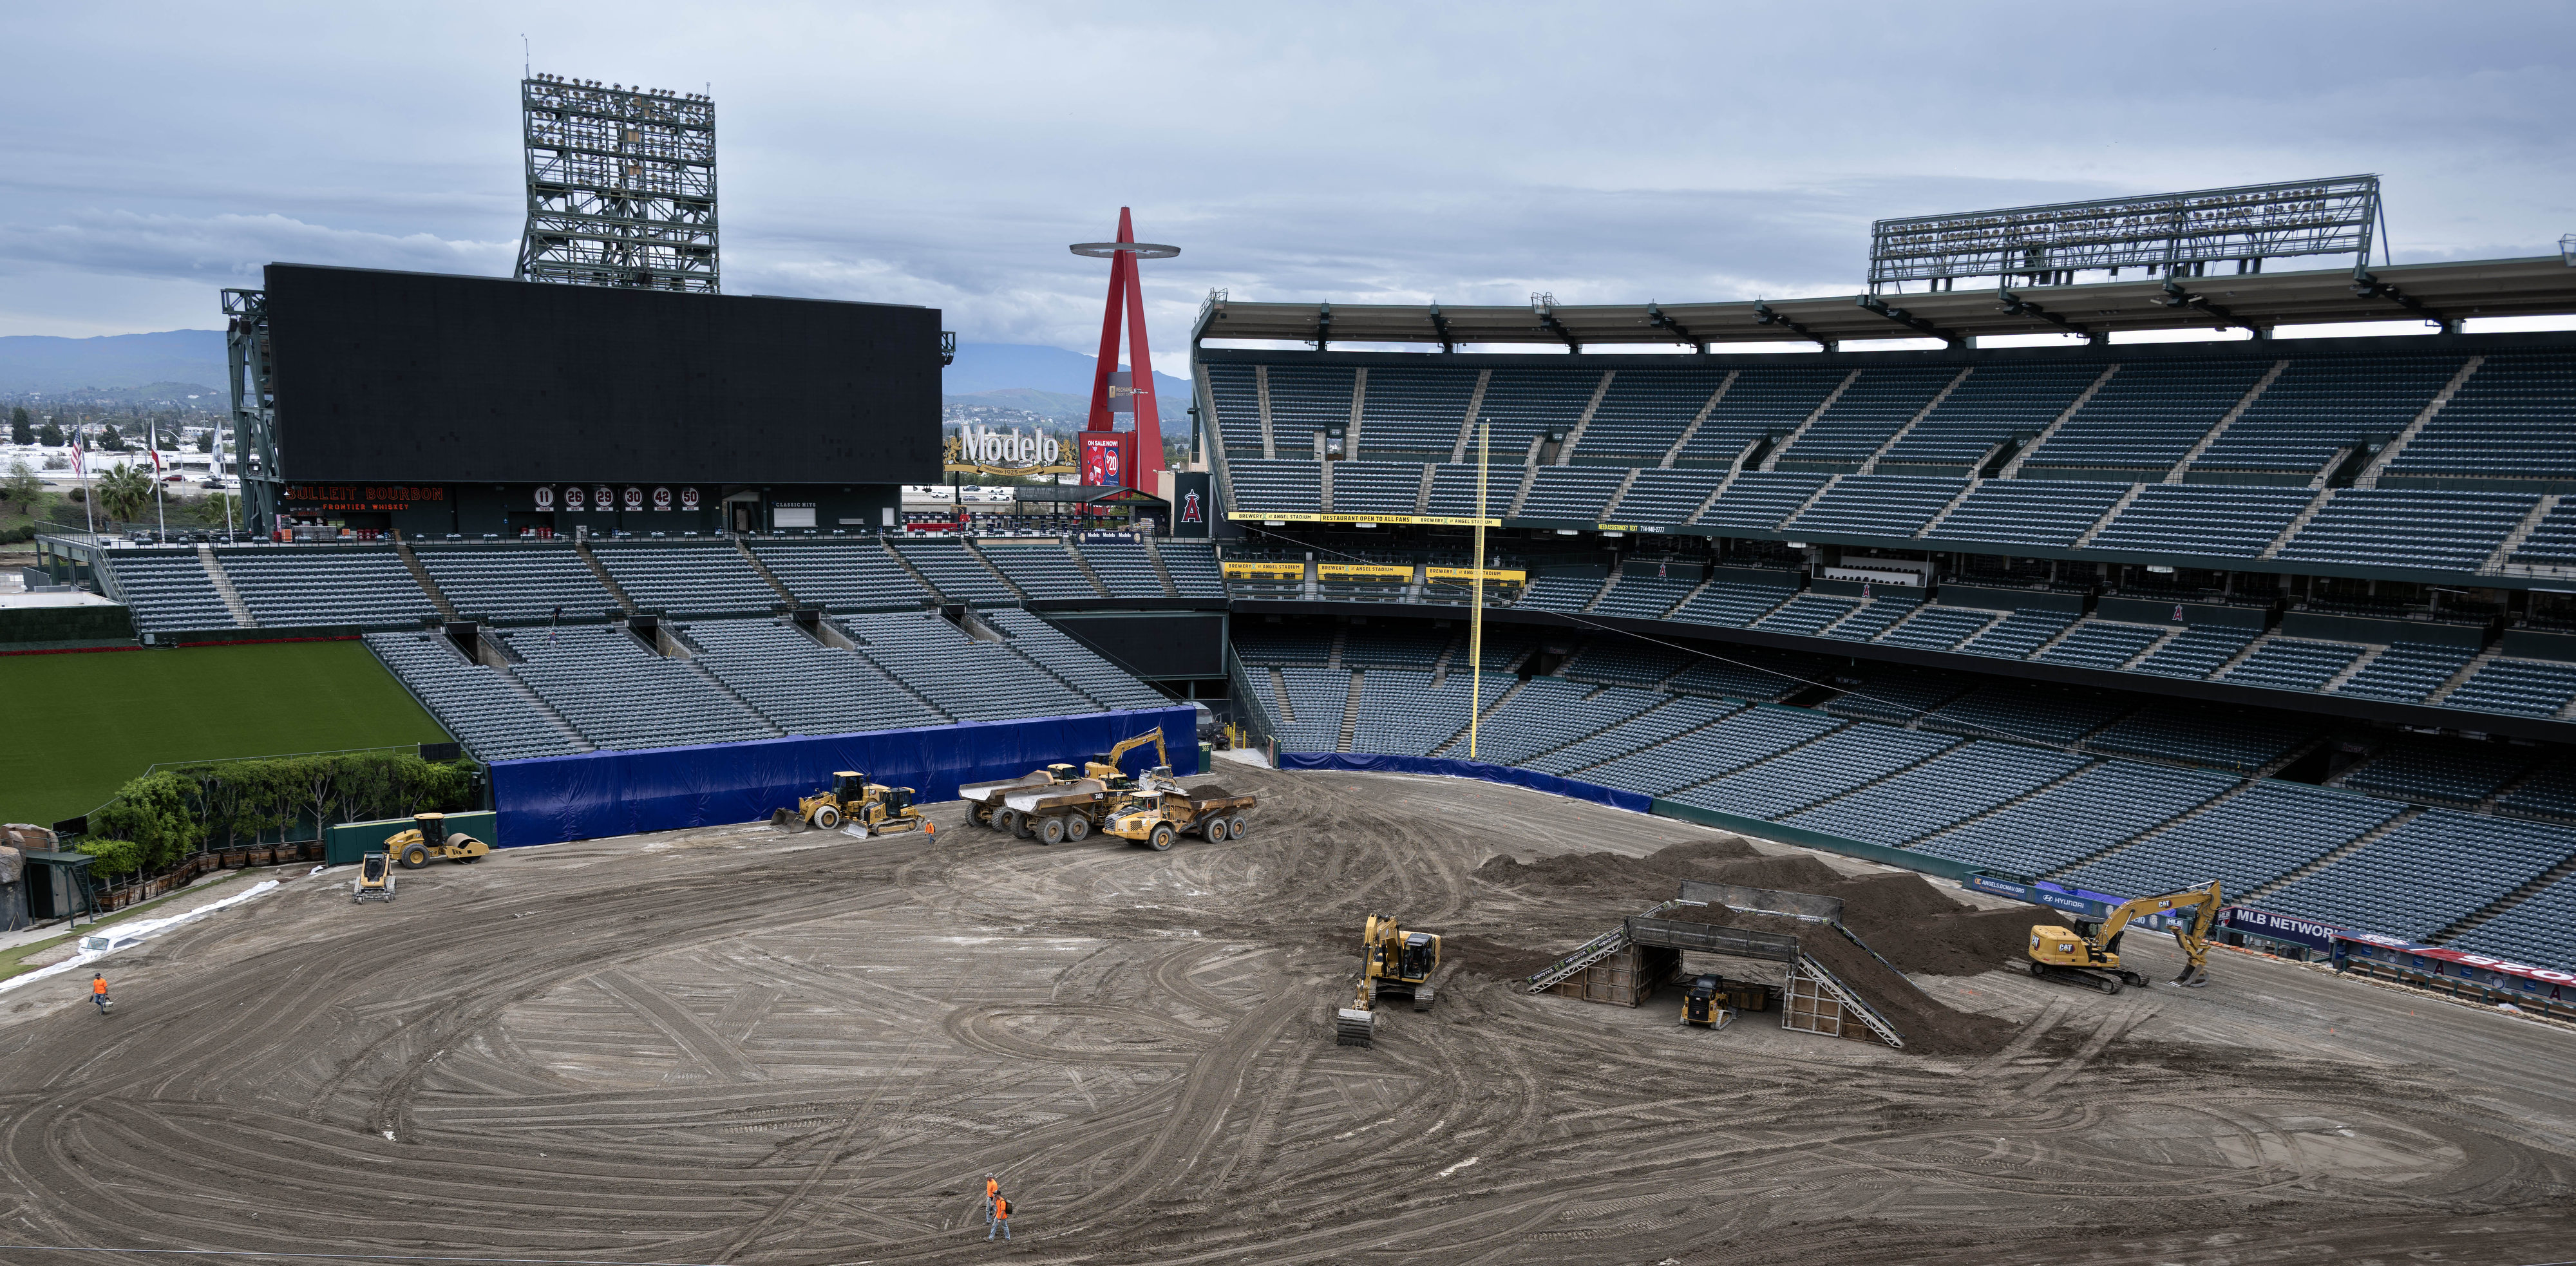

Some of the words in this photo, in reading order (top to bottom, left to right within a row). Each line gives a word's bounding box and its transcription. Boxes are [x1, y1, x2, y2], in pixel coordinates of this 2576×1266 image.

[961, 424, 1059, 462] Modelo
[1106, 455, 1117, 471] $20
[285, 487, 357, 500] BULLEIT
[366, 487, 443, 500] BOURBON
[539, 491, 549, 502] 11
[568, 491, 583, 502] 26
[598, 491, 612, 502] 29
[627, 491, 641, 502] 30
[655, 491, 670, 502] 42
[684, 491, 697, 502] 50
[1982, 880, 2025, 894] ANGELS.OCNAV.ORG
[2054, 897, 2084, 909] HYUNDAI
[2158, 900, 2170, 908] CAT
[2237, 909, 2266, 925] MLB
[2031, 934, 2040, 947] CAT
[2059, 943, 2072, 952] CAT
[1533, 968, 1554, 980] MONSTER
[1565, 950, 1587, 964] MONSTER
[1598, 934, 1620, 947] MONSTER
[2433, 959, 2445, 975] A
[2549, 985, 2561, 1001] A
